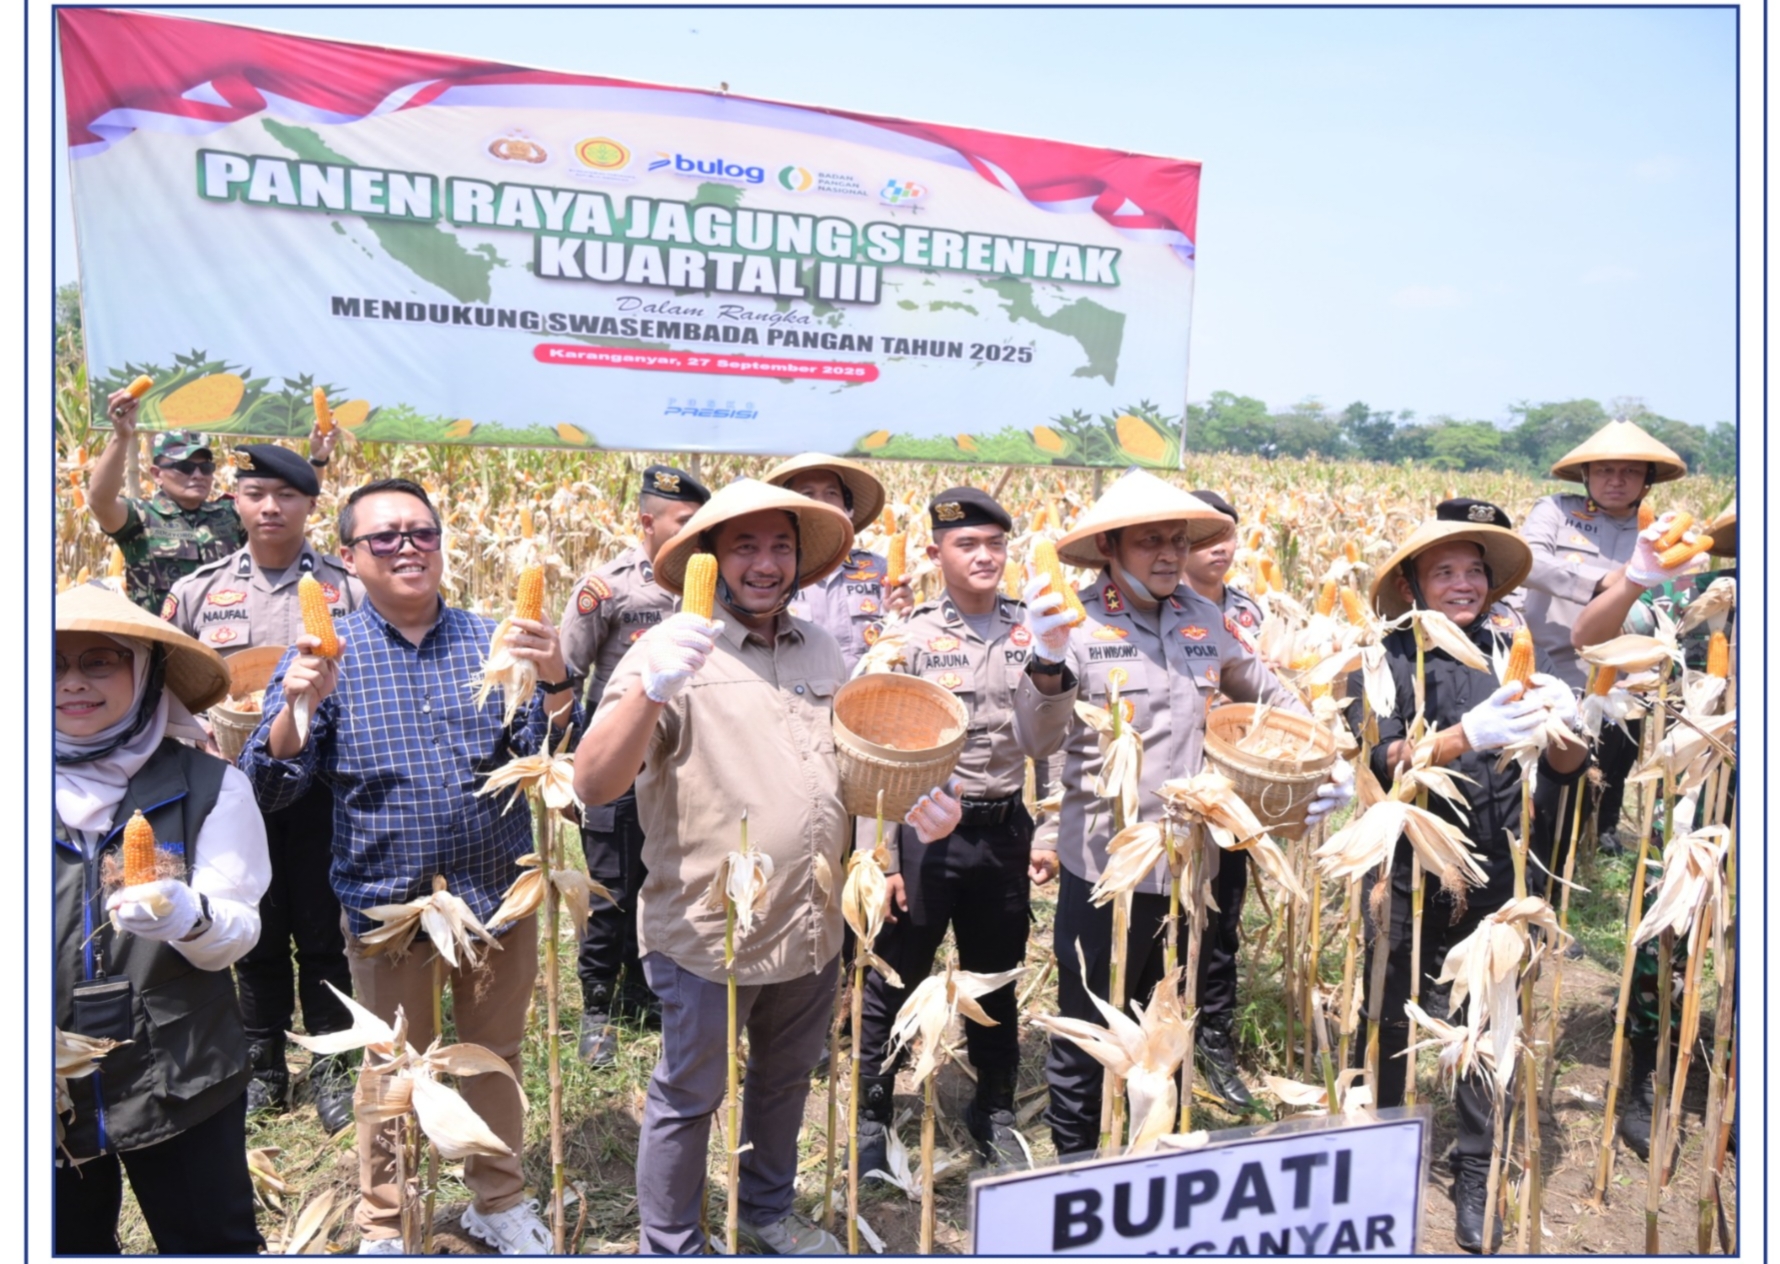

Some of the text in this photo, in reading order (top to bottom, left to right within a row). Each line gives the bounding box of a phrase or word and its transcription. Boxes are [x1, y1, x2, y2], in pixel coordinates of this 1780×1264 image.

[675, 153, 765, 184] bulog
[818, 172, 854, 182] BADAN
[818, 178, 860, 189] PANGAN
[818, 185, 869, 197] NASIONAL
[202, 151, 1119, 285] PANEN RAYA JAGUNG SERENTAK
[540, 234, 878, 303] KUARTAL III
[615, 295, 813, 327] Dalam Rangka
[330, 295, 1034, 364] MENDUKUNG SWASEMBADA PANGAN TAHUN 2025
[549, 348, 867, 377] Karanganyar, 27 September 2025
[663, 406, 759, 420] PRESISI
[1565, 518, 1598, 534] HADI
[202, 608, 249, 623] NAUFAL
[330, 607, 347, 619] RI
[1004, 650, 1027, 663] PO
[1088, 644, 1138, 660] RH WIBOWO
[1184, 644, 1219, 658] POLRI
[925, 653, 970, 669] ARJUNA
[1051, 1147, 1353, 1252] BUPATI
